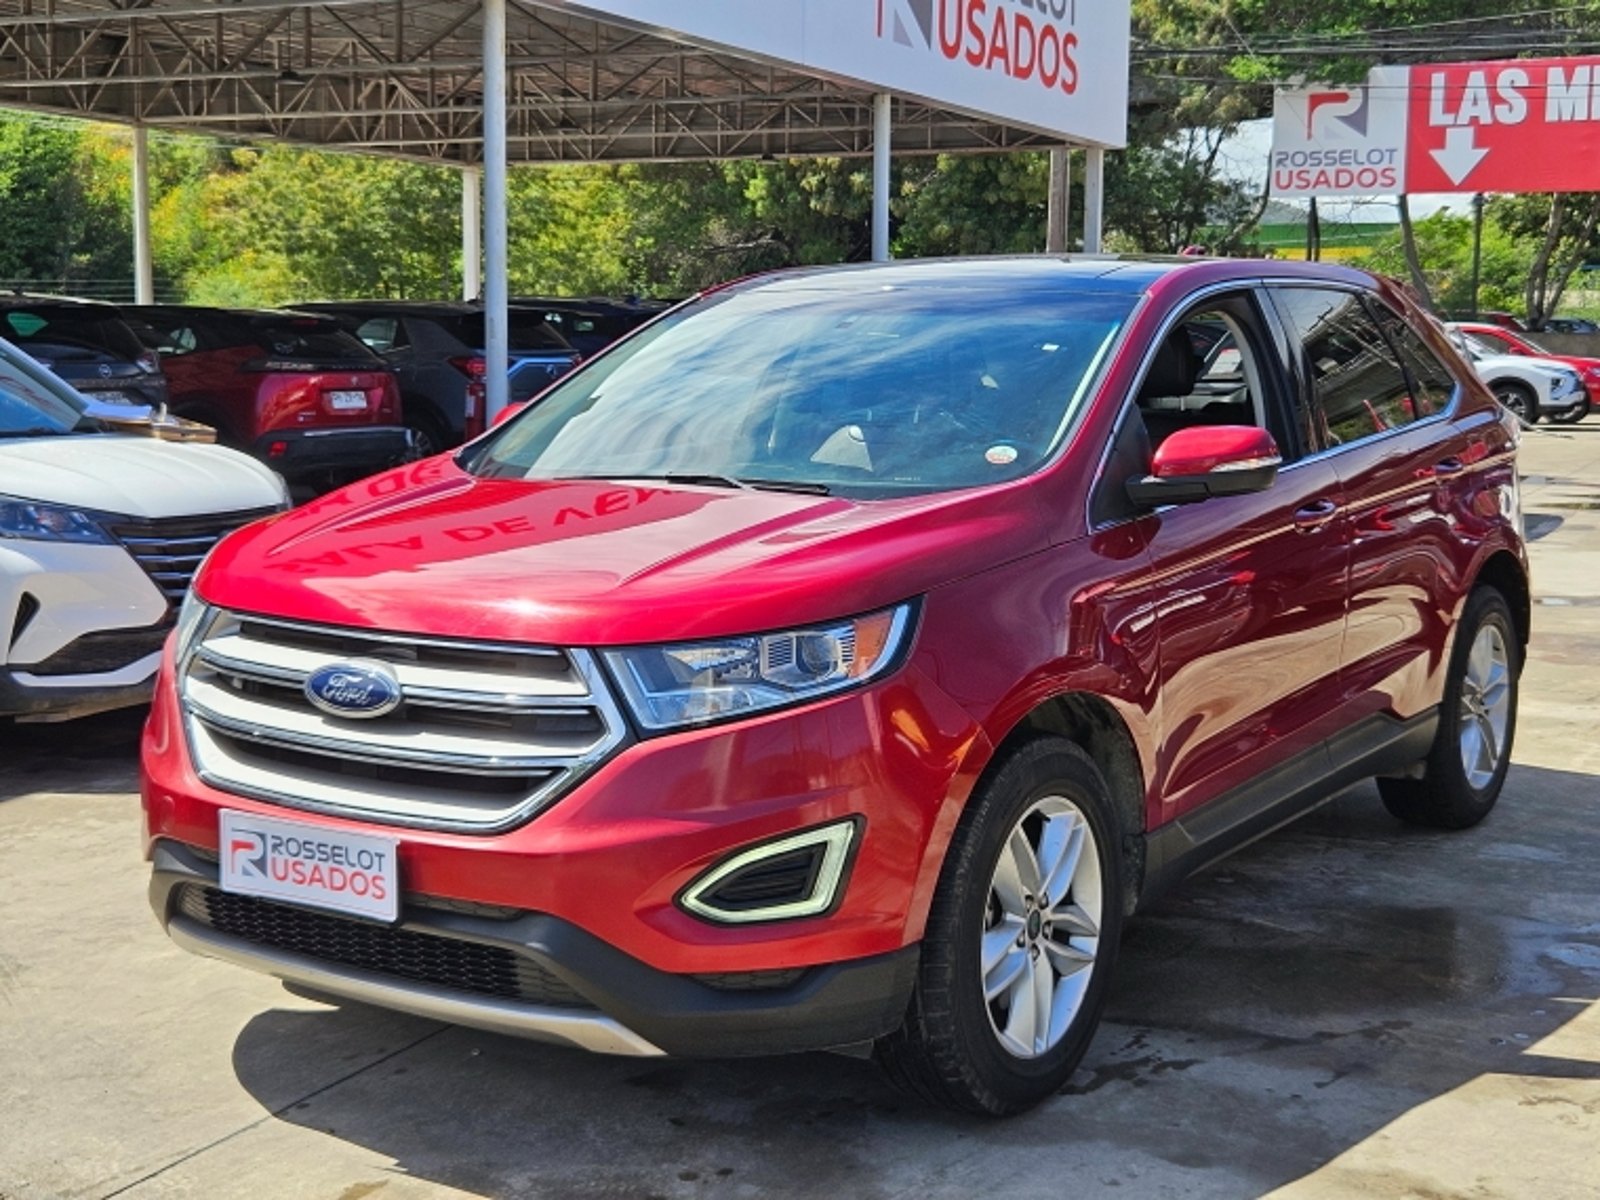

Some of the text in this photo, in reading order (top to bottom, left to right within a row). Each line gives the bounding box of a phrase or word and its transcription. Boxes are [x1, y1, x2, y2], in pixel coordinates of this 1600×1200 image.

[938, 0, 1078, 95] USADOS
[1429, 65, 1600, 126] LAS M
[1275, 148, 1398, 167] ROSSELOT
[1274, 167, 1397, 190] USADOS
[322, 673, 374, 705] Ford
[271, 835, 385, 872] ROSSELOT
[271, 857, 386, 900] USADOS
